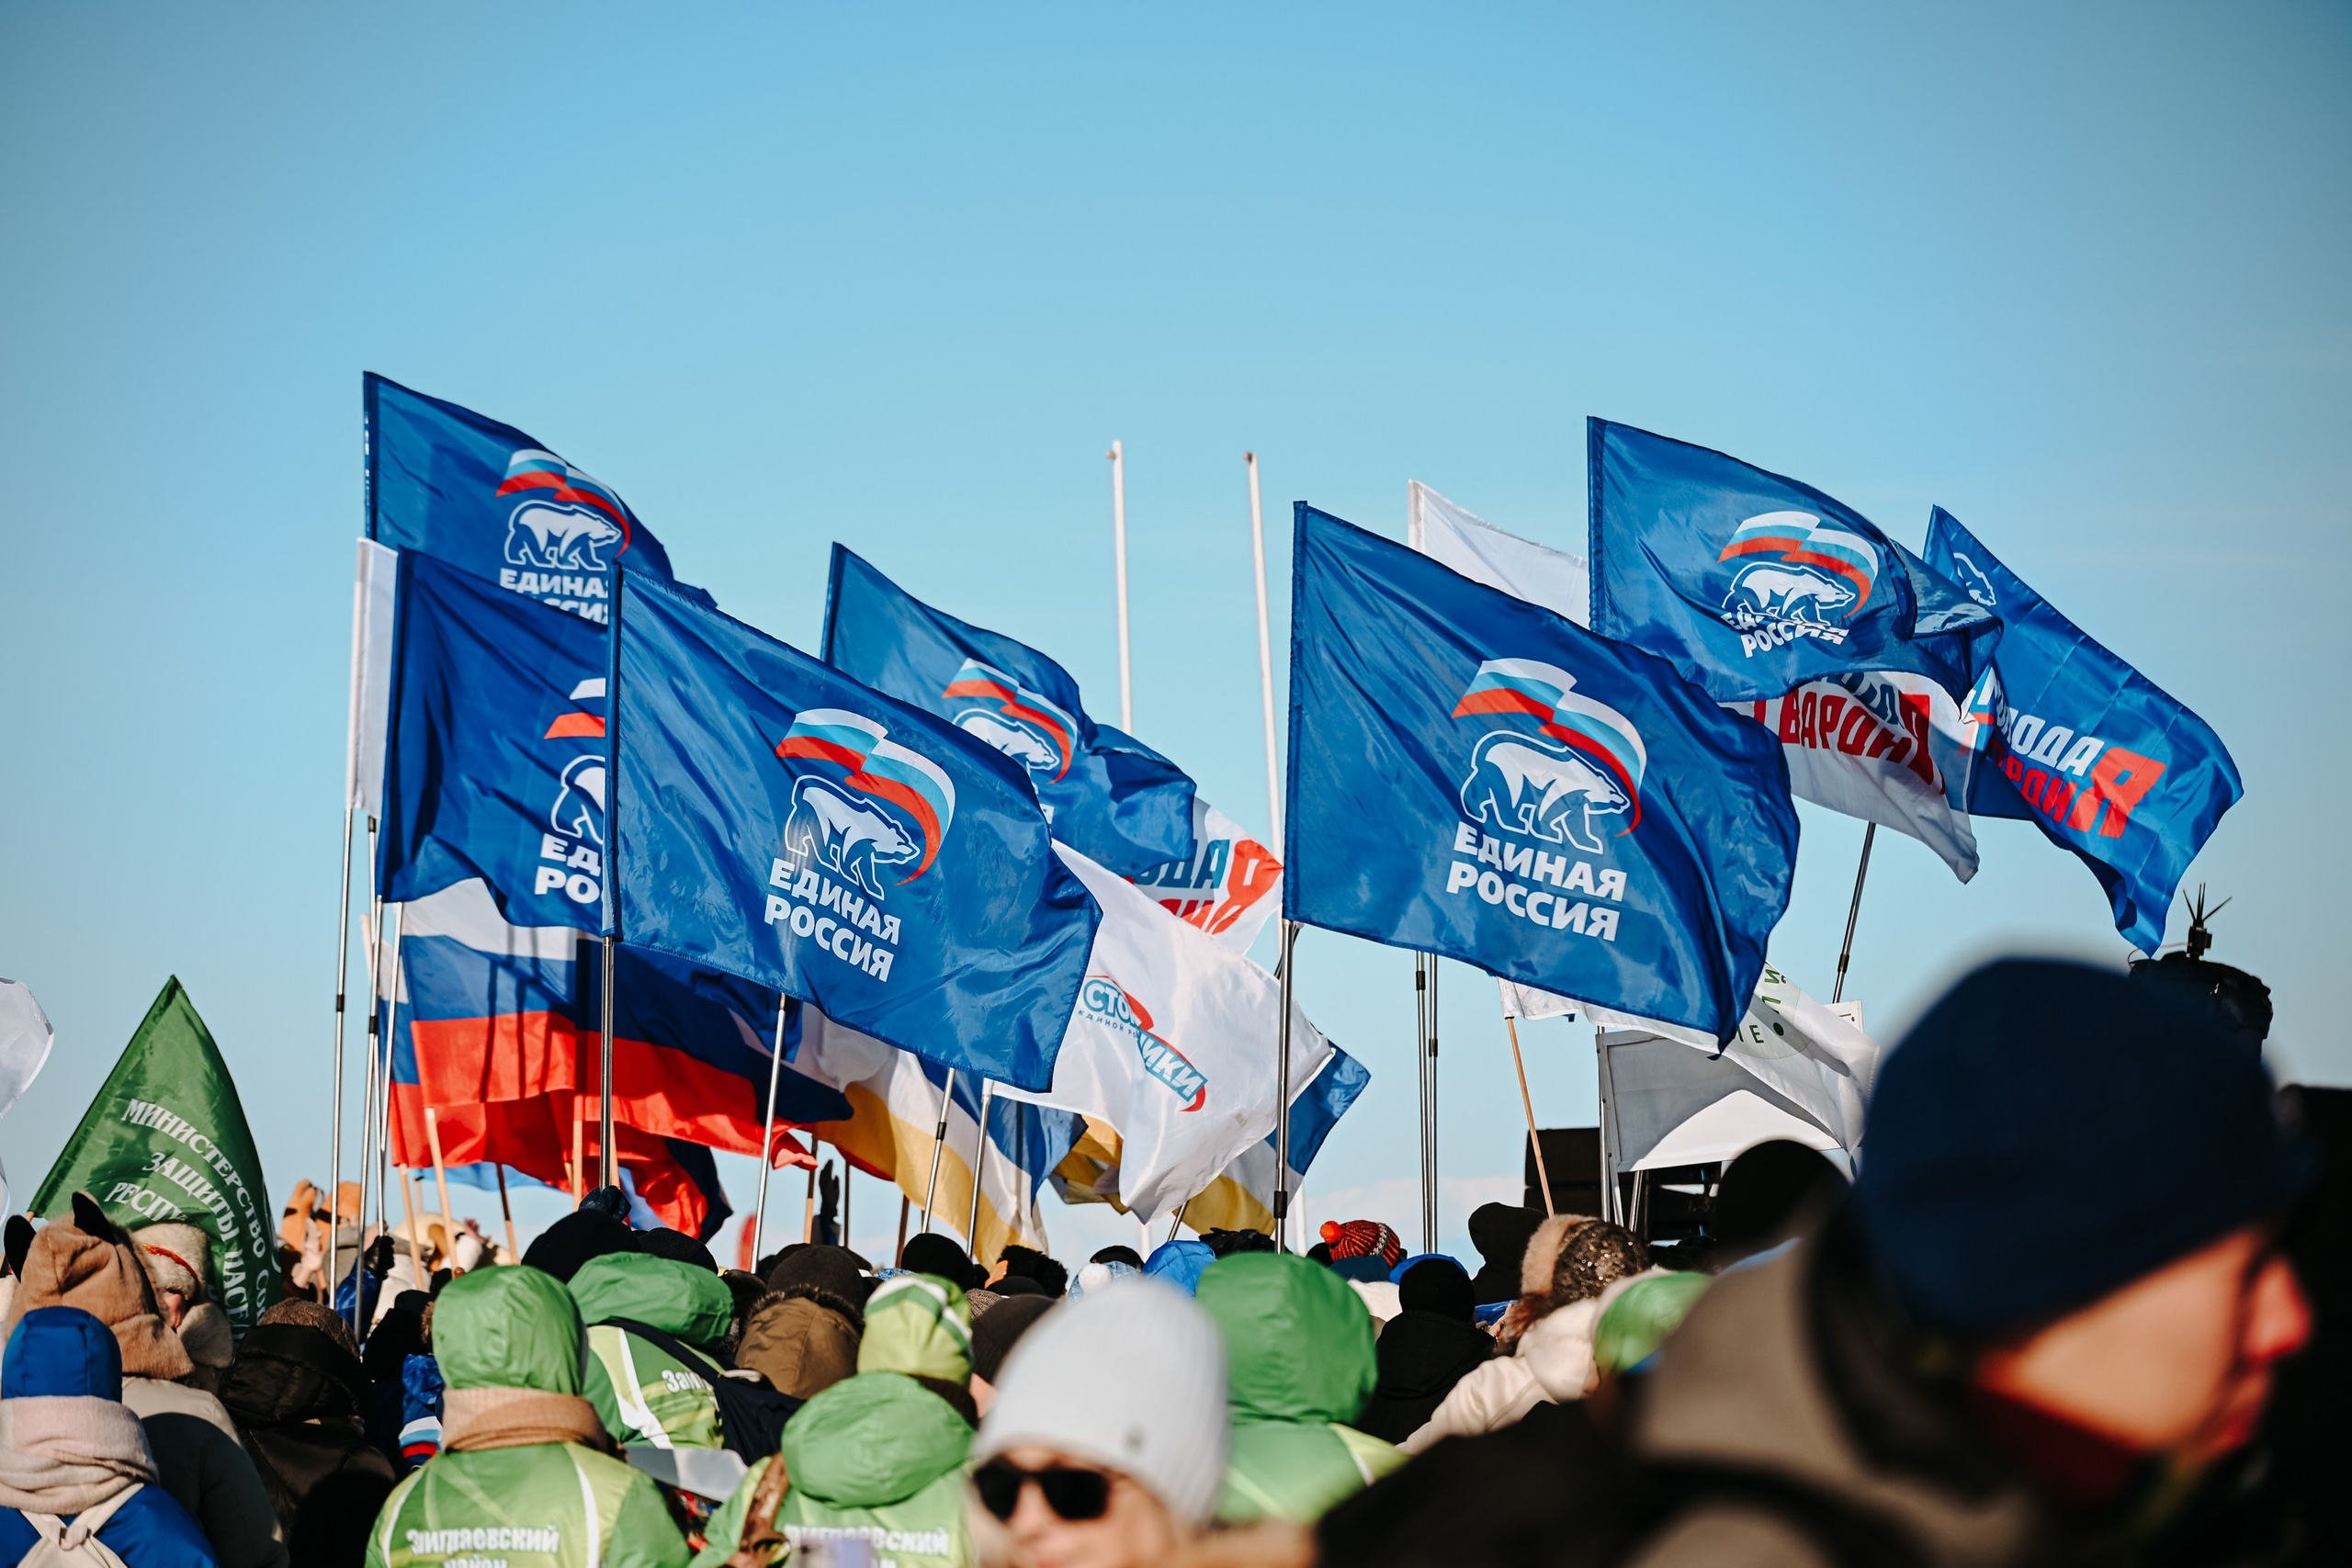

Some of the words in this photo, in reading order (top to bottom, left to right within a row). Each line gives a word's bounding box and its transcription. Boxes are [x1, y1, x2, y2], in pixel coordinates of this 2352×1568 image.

[499, 567, 609, 599] ЕДИНА
[534, 865, 604, 904] РО
[539, 832, 602, 877] ЕД
[1453, 821, 1628, 902] ЕДИНАЯ
[763, 894, 895, 983] РОССИЯ
[769, 857, 902, 946] ЕДИНАЯ
[1445, 860, 1621, 942] РОССИЯ
[1078, 1010, 1124, 1032] ЕДИНОЙ
[120, 1098, 266, 1258] МИНИСТЕРСТВО
[141, 1151, 241, 1243] ЗАЩИТЫ
